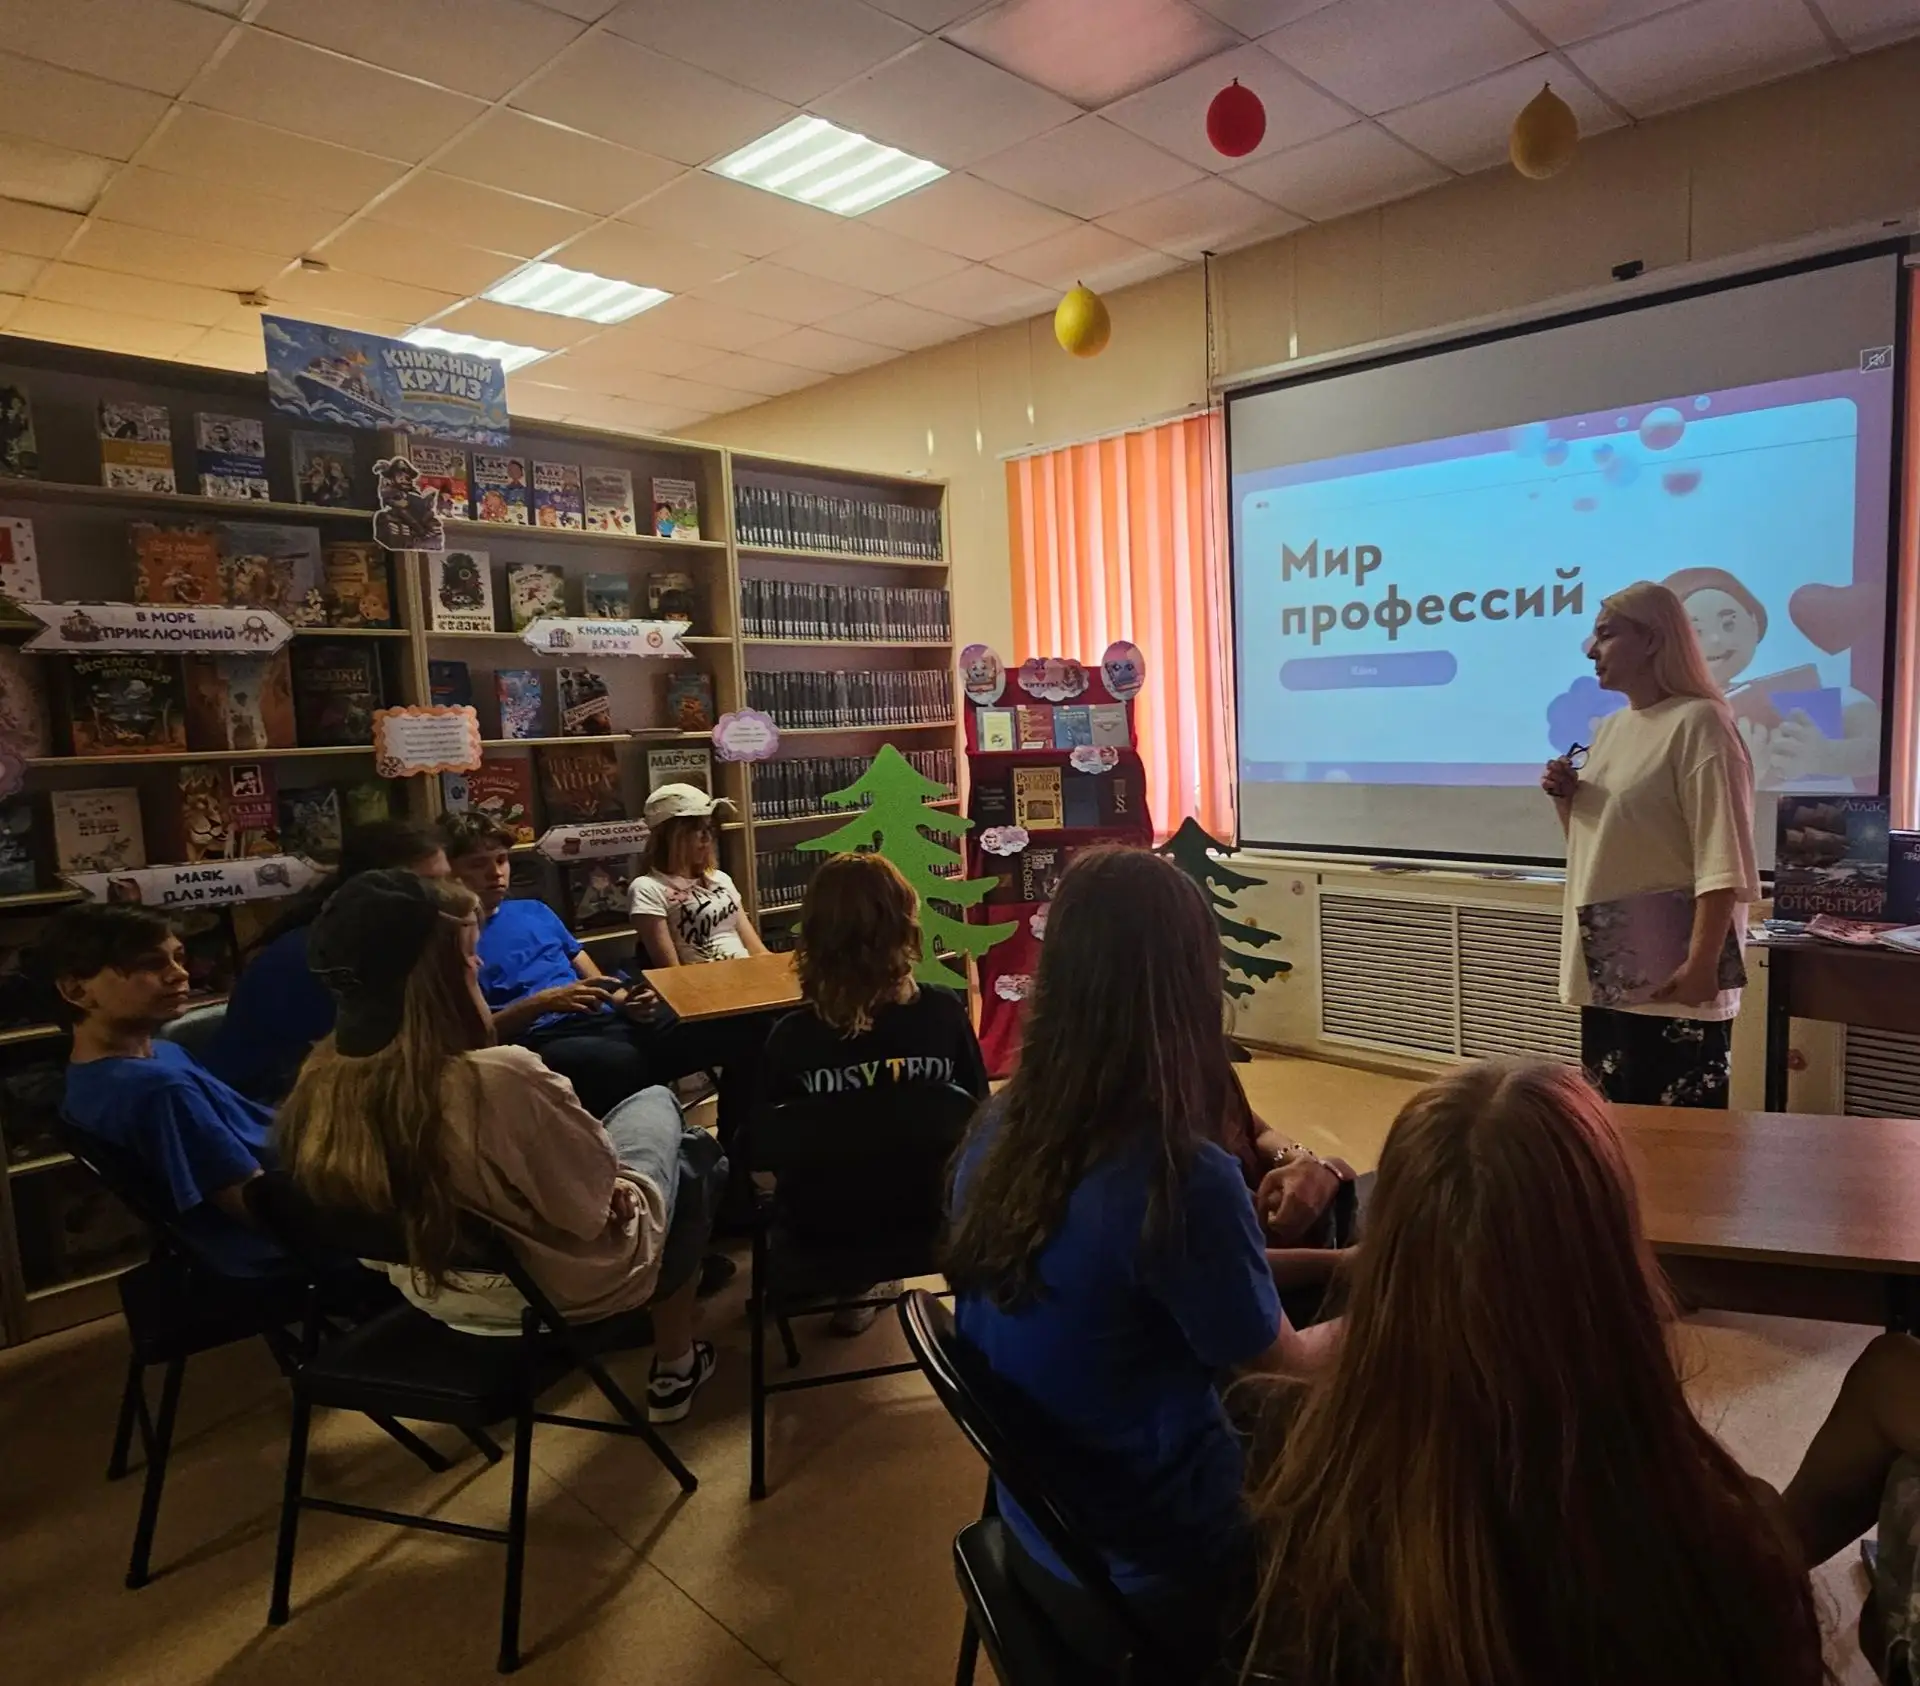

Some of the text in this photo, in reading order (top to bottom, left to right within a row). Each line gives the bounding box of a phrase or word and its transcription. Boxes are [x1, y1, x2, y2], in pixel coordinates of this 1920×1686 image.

[381, 347, 492, 384] КНИЖНЫЙ
[396, 367, 483, 401] КРУИЗ
[1282, 538, 1382, 586] Мир
[1282, 566, 1584, 646] профессий
[135, 611, 197, 624] В МОРЕ
[101, 626, 236, 641] ПРИКЛЮЧЕНИЙ
[577, 623, 640, 637] КНИЖНЫЙ
[591, 639, 632, 650] БАГАЖ
[650, 754, 707, 767] МАРУСЯ
[579, 827, 611, 838] ОСТРОВ
[174, 870, 225, 884] МАЯК
[163, 884, 245, 905] ДЛЯ УМА
[1779, 893, 1884, 914] ОТКРЫТИЙ
